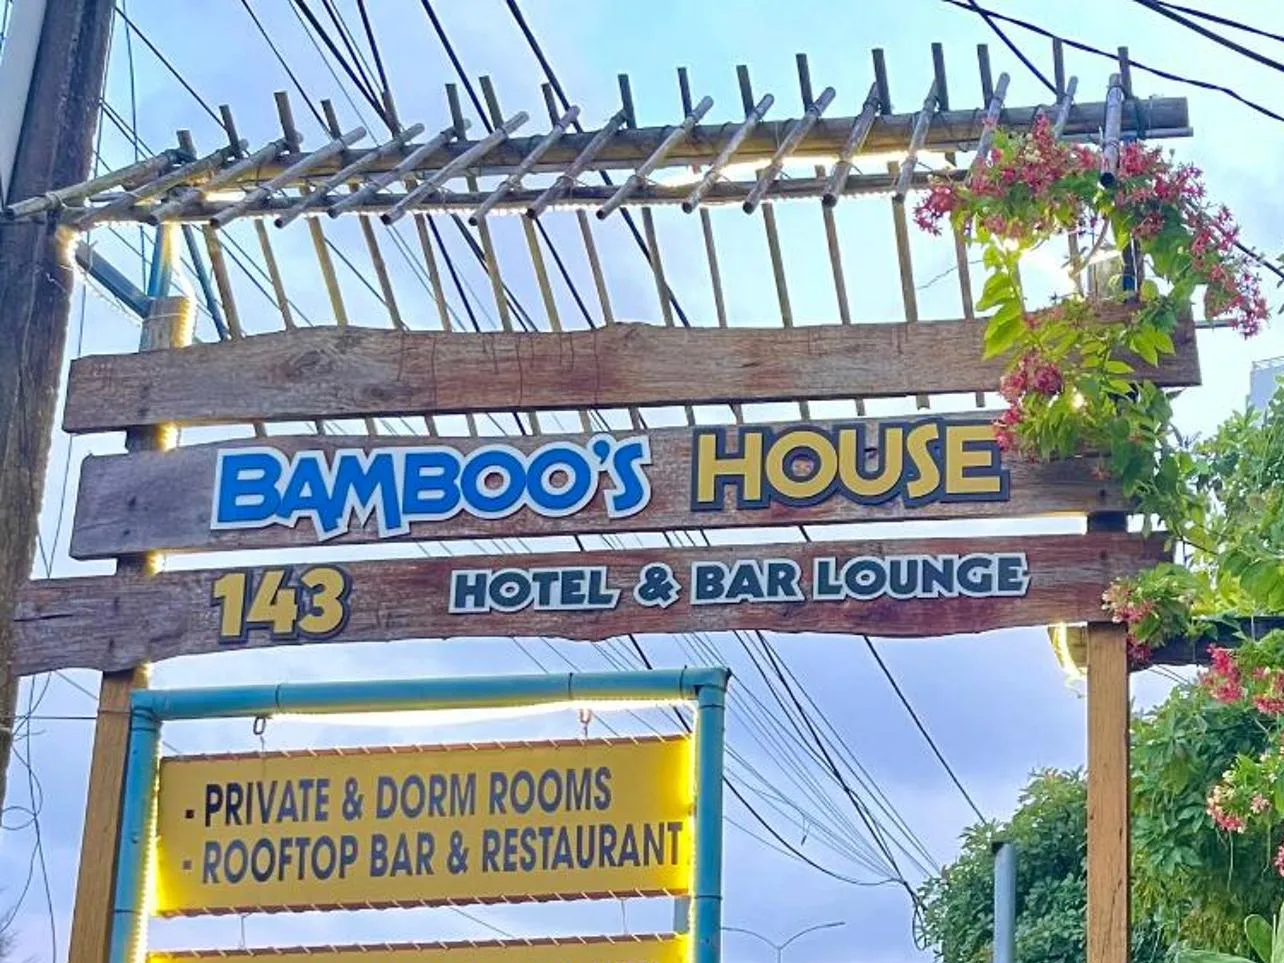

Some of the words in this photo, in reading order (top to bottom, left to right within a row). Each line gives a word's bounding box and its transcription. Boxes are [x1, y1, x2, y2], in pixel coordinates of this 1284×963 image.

[210, 432, 651, 541] BAMBOO'S
[690, 418, 1010, 512] HOUSE
[212, 564, 353, 644] 143
[448, 566, 622, 614] HOTEL
[634, 562, 681, 609] &
[691, 557, 804, 606] BAR
[813, 552, 1030, 601] LOUNGE
[204, 777, 331, 828] PRIVATE
[342, 775, 364, 822] &
[376, 770, 477, 819] DORM
[489, 766, 613, 815] ROOMS
[202, 833, 358, 885] ROOFTOP
[369, 830, 435, 878] BAR
[446, 828, 470, 875] &
[481, 821, 685, 873] RESTAURANT
